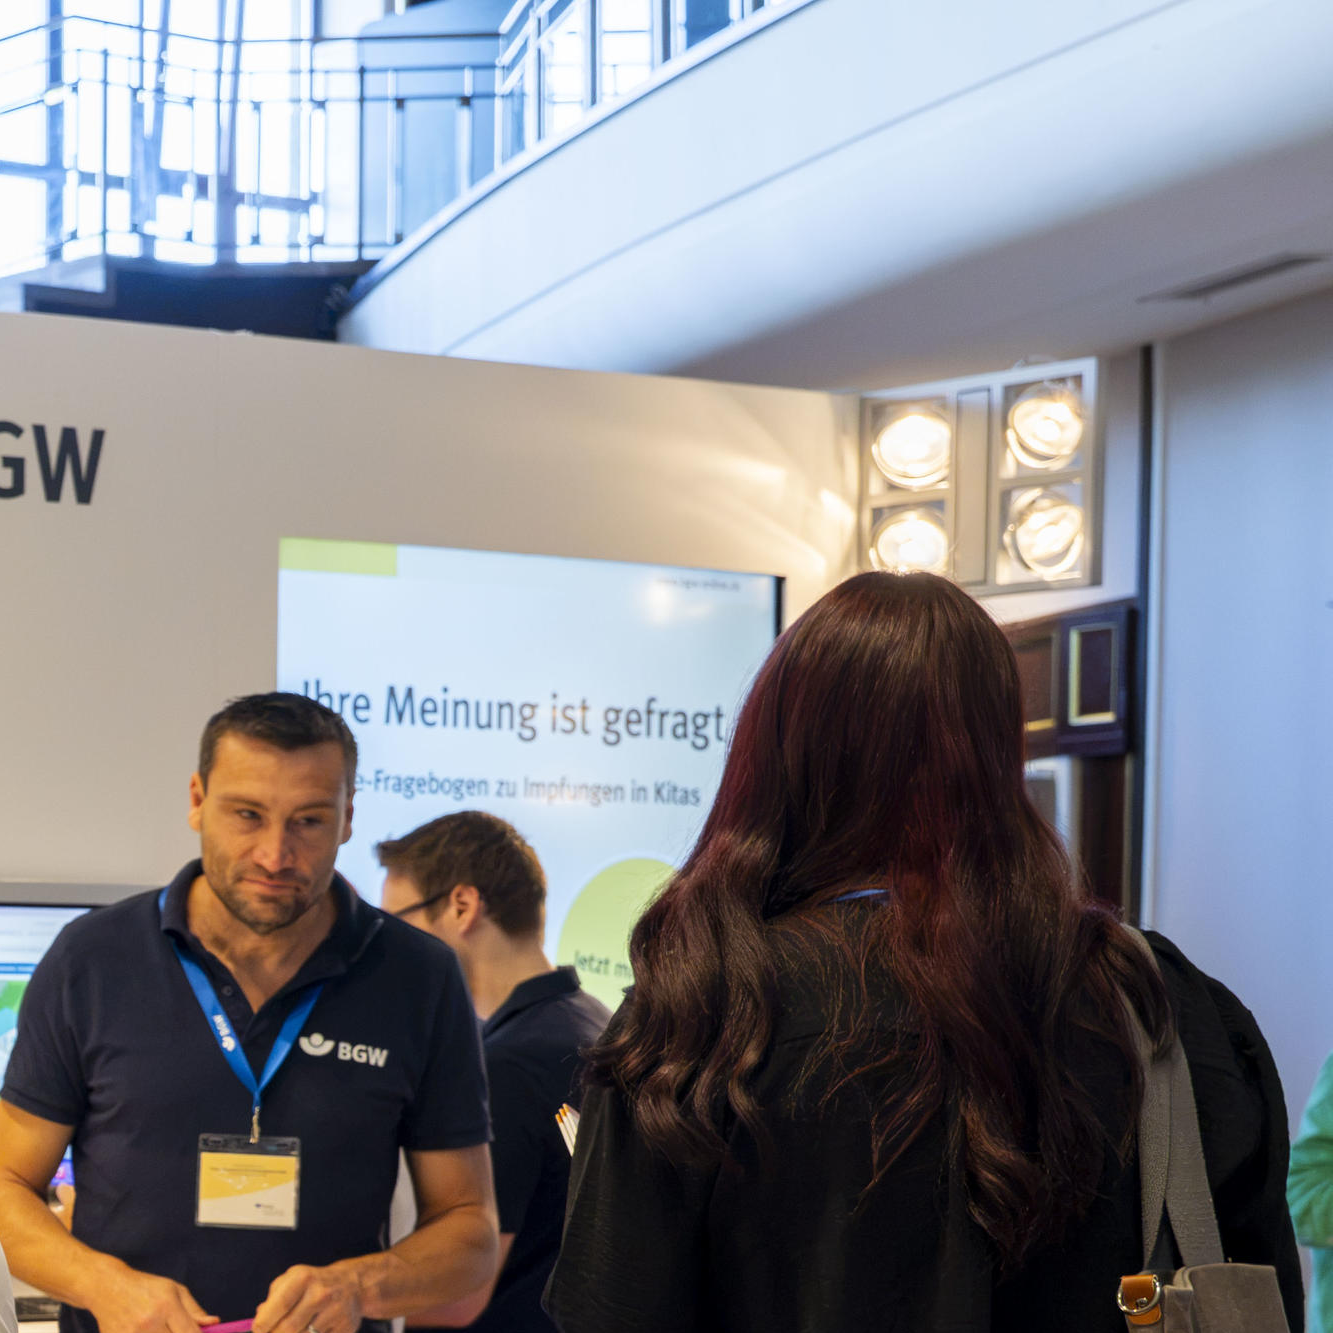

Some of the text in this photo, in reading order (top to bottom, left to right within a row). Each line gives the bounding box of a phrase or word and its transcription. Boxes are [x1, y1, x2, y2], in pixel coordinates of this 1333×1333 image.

[384, 685, 538, 742] Meinung
[550, 693, 591, 736] ist
[355, 769, 701, 807] e-Fragebogen zu Impfungen in Kitas
[337, 1041, 389, 1068] BGW
